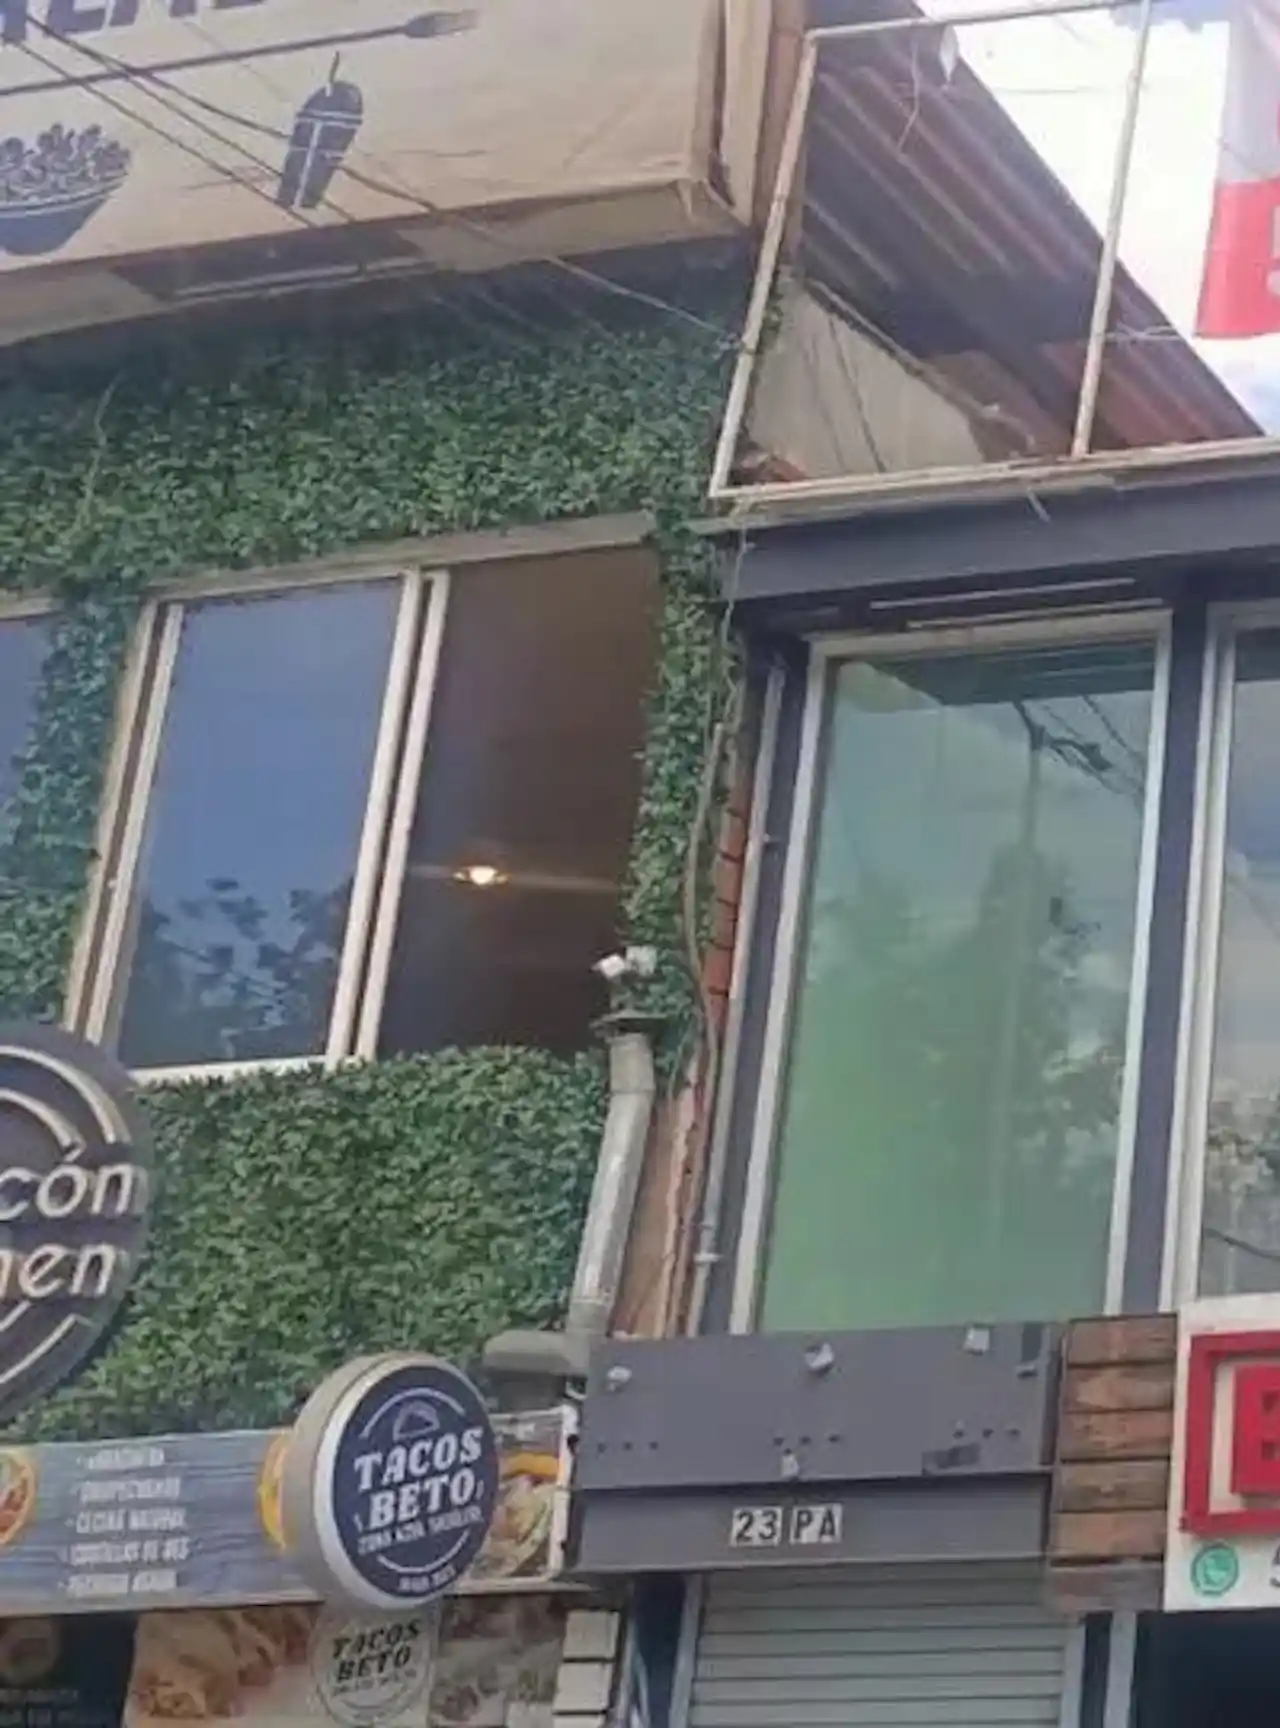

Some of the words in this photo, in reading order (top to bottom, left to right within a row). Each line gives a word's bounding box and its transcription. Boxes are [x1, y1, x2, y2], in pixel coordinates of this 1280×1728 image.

[353, 1427, 484, 1491] TACOS
[369, 1467, 476, 1530] BETO
[735, 1511, 778, 1545] 23
[794, 1508, 837, 1541] PA
[332, 1619, 420, 1659] TACOS
[337, 1645, 412, 1684] BETO
